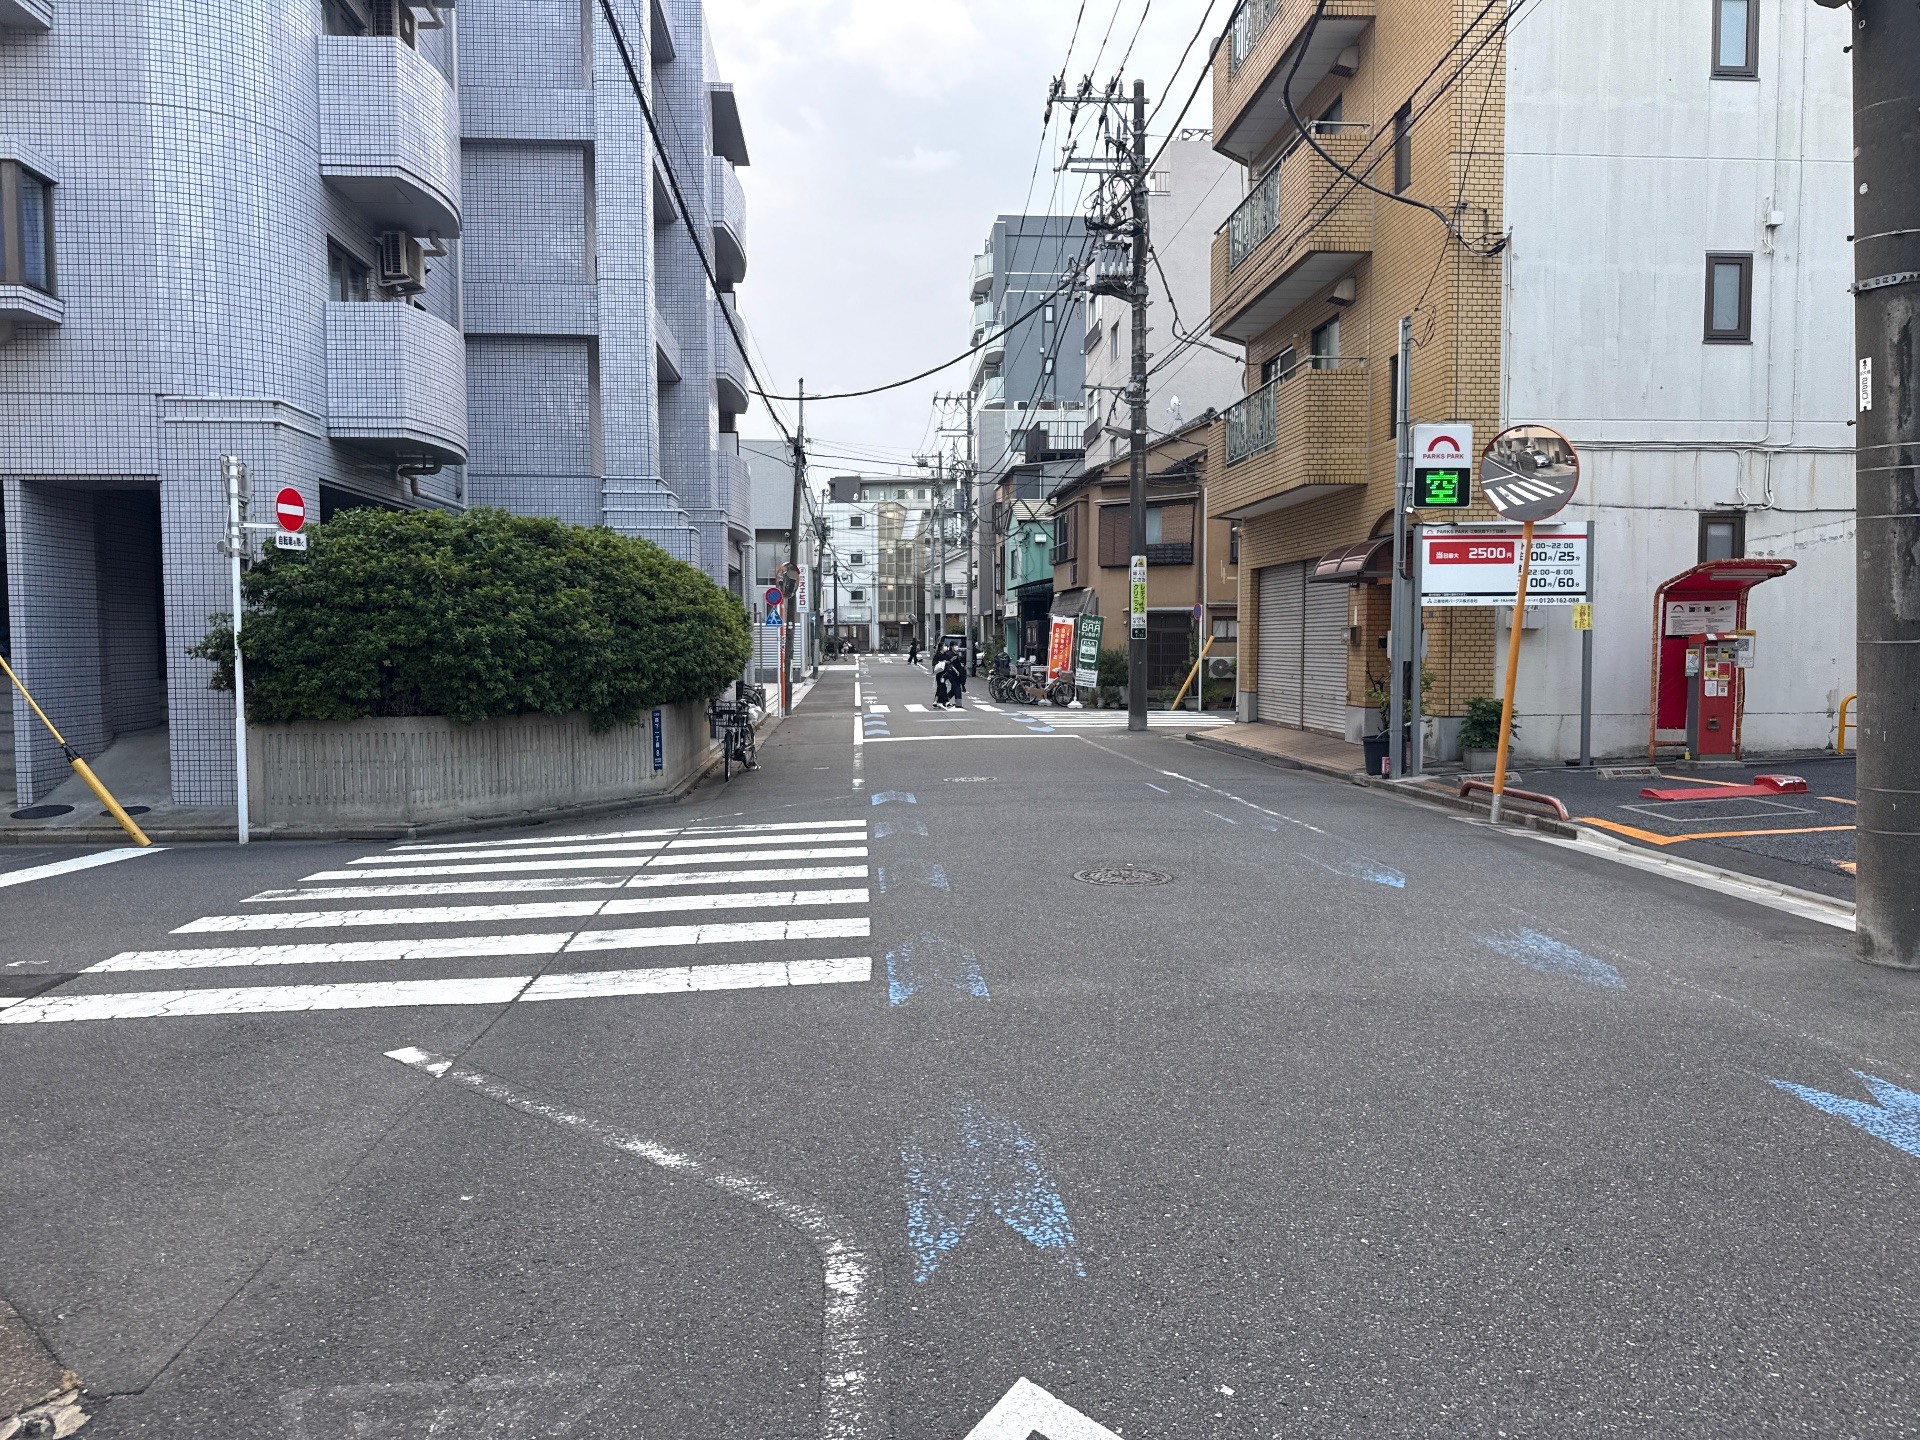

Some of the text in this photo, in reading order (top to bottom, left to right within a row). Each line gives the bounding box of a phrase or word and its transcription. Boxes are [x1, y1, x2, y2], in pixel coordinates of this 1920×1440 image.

[1426, 470, 1458, 503] 空
[278, 535, 305, 548] 自転車を除く
[1435, 547, 1512, 559] 当日最大 2500円
[1081, 622, 1101, 633] BAA
